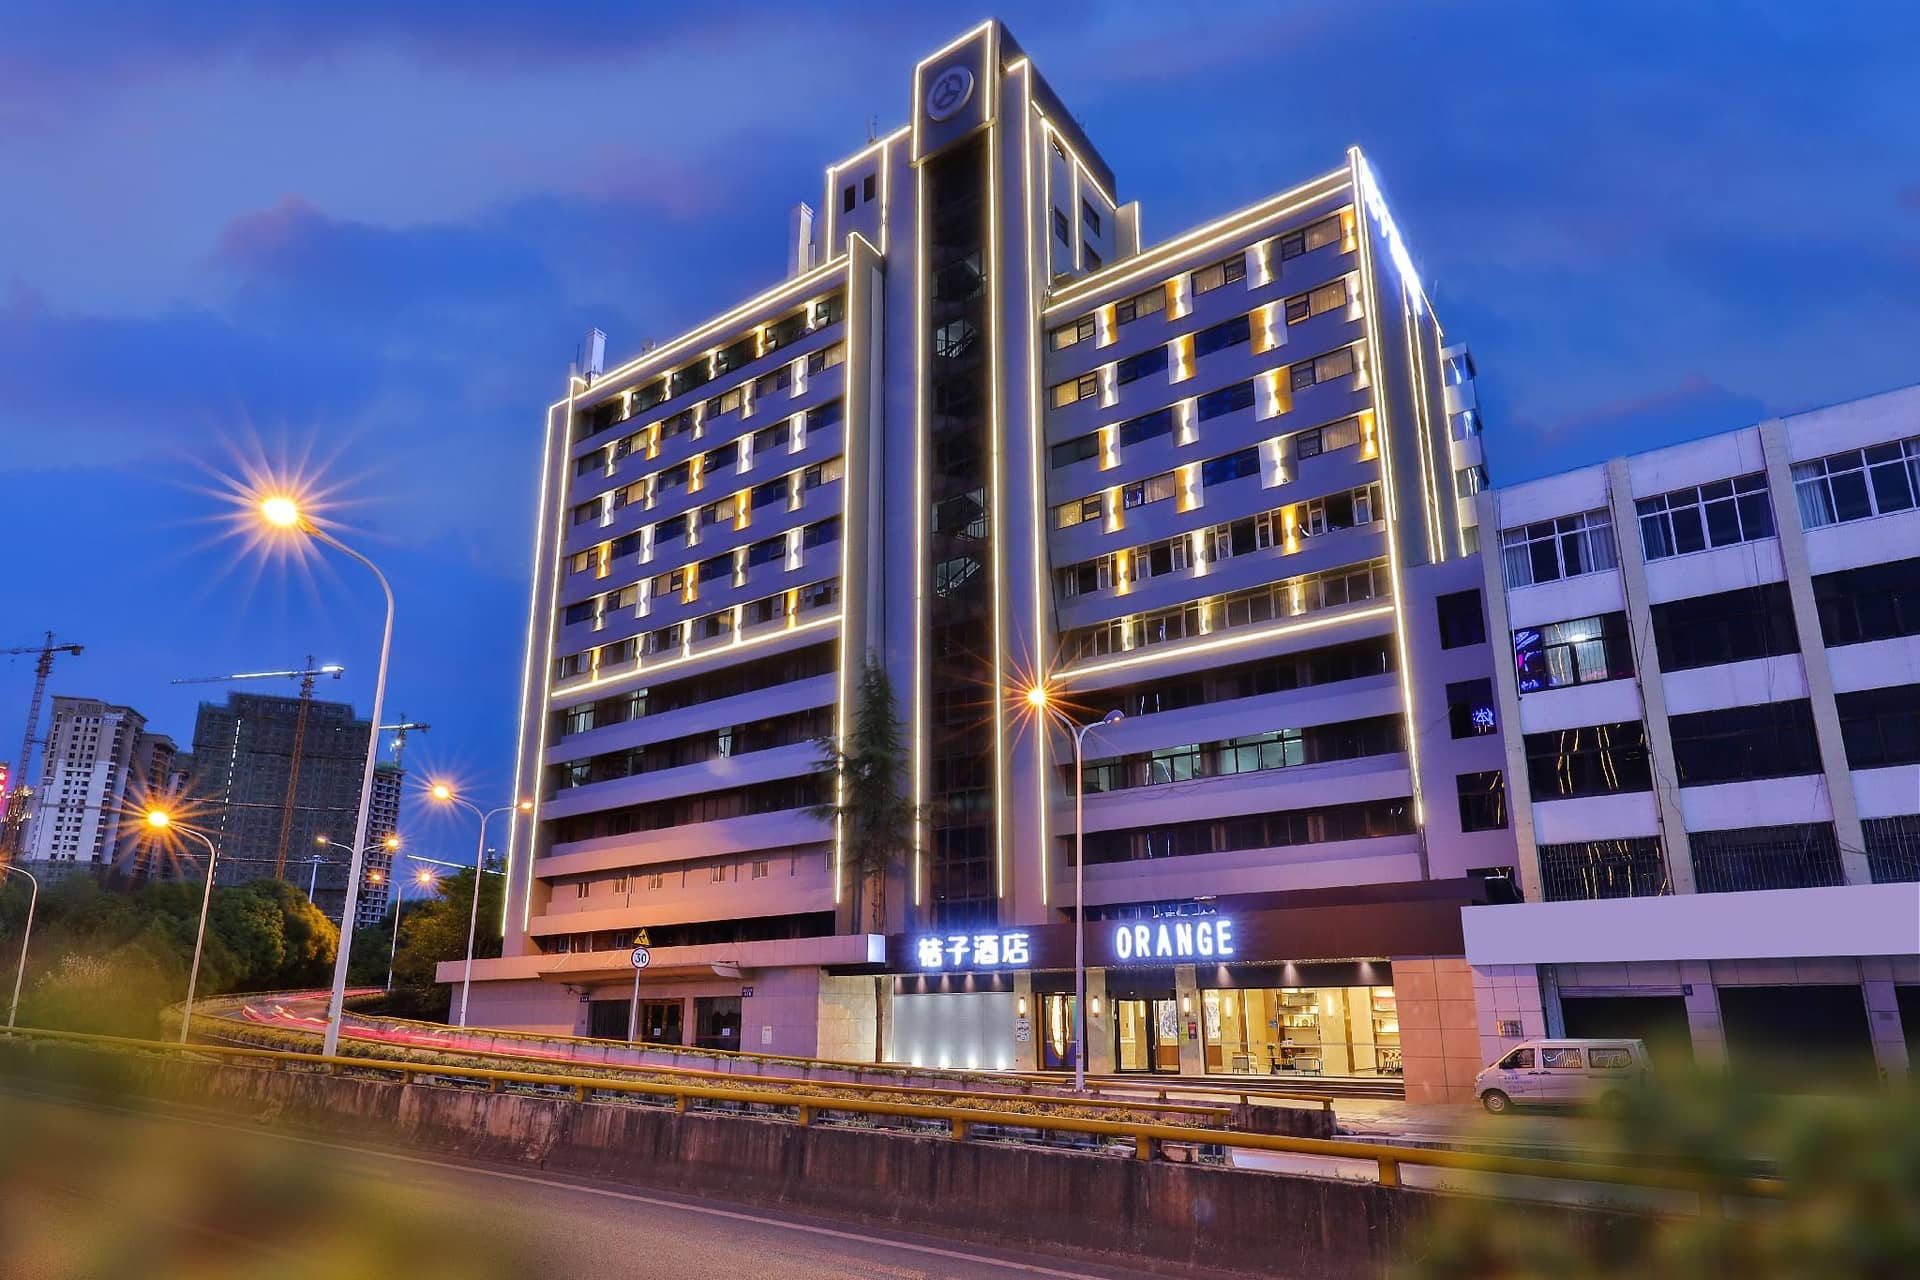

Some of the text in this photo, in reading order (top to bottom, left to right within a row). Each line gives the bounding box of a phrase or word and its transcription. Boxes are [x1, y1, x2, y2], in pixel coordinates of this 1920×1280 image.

[918, 933, 1030, 967] 桔子酒店
[1116, 920, 1234, 959] ORANGE
[635, 953, 646, 963] 30
